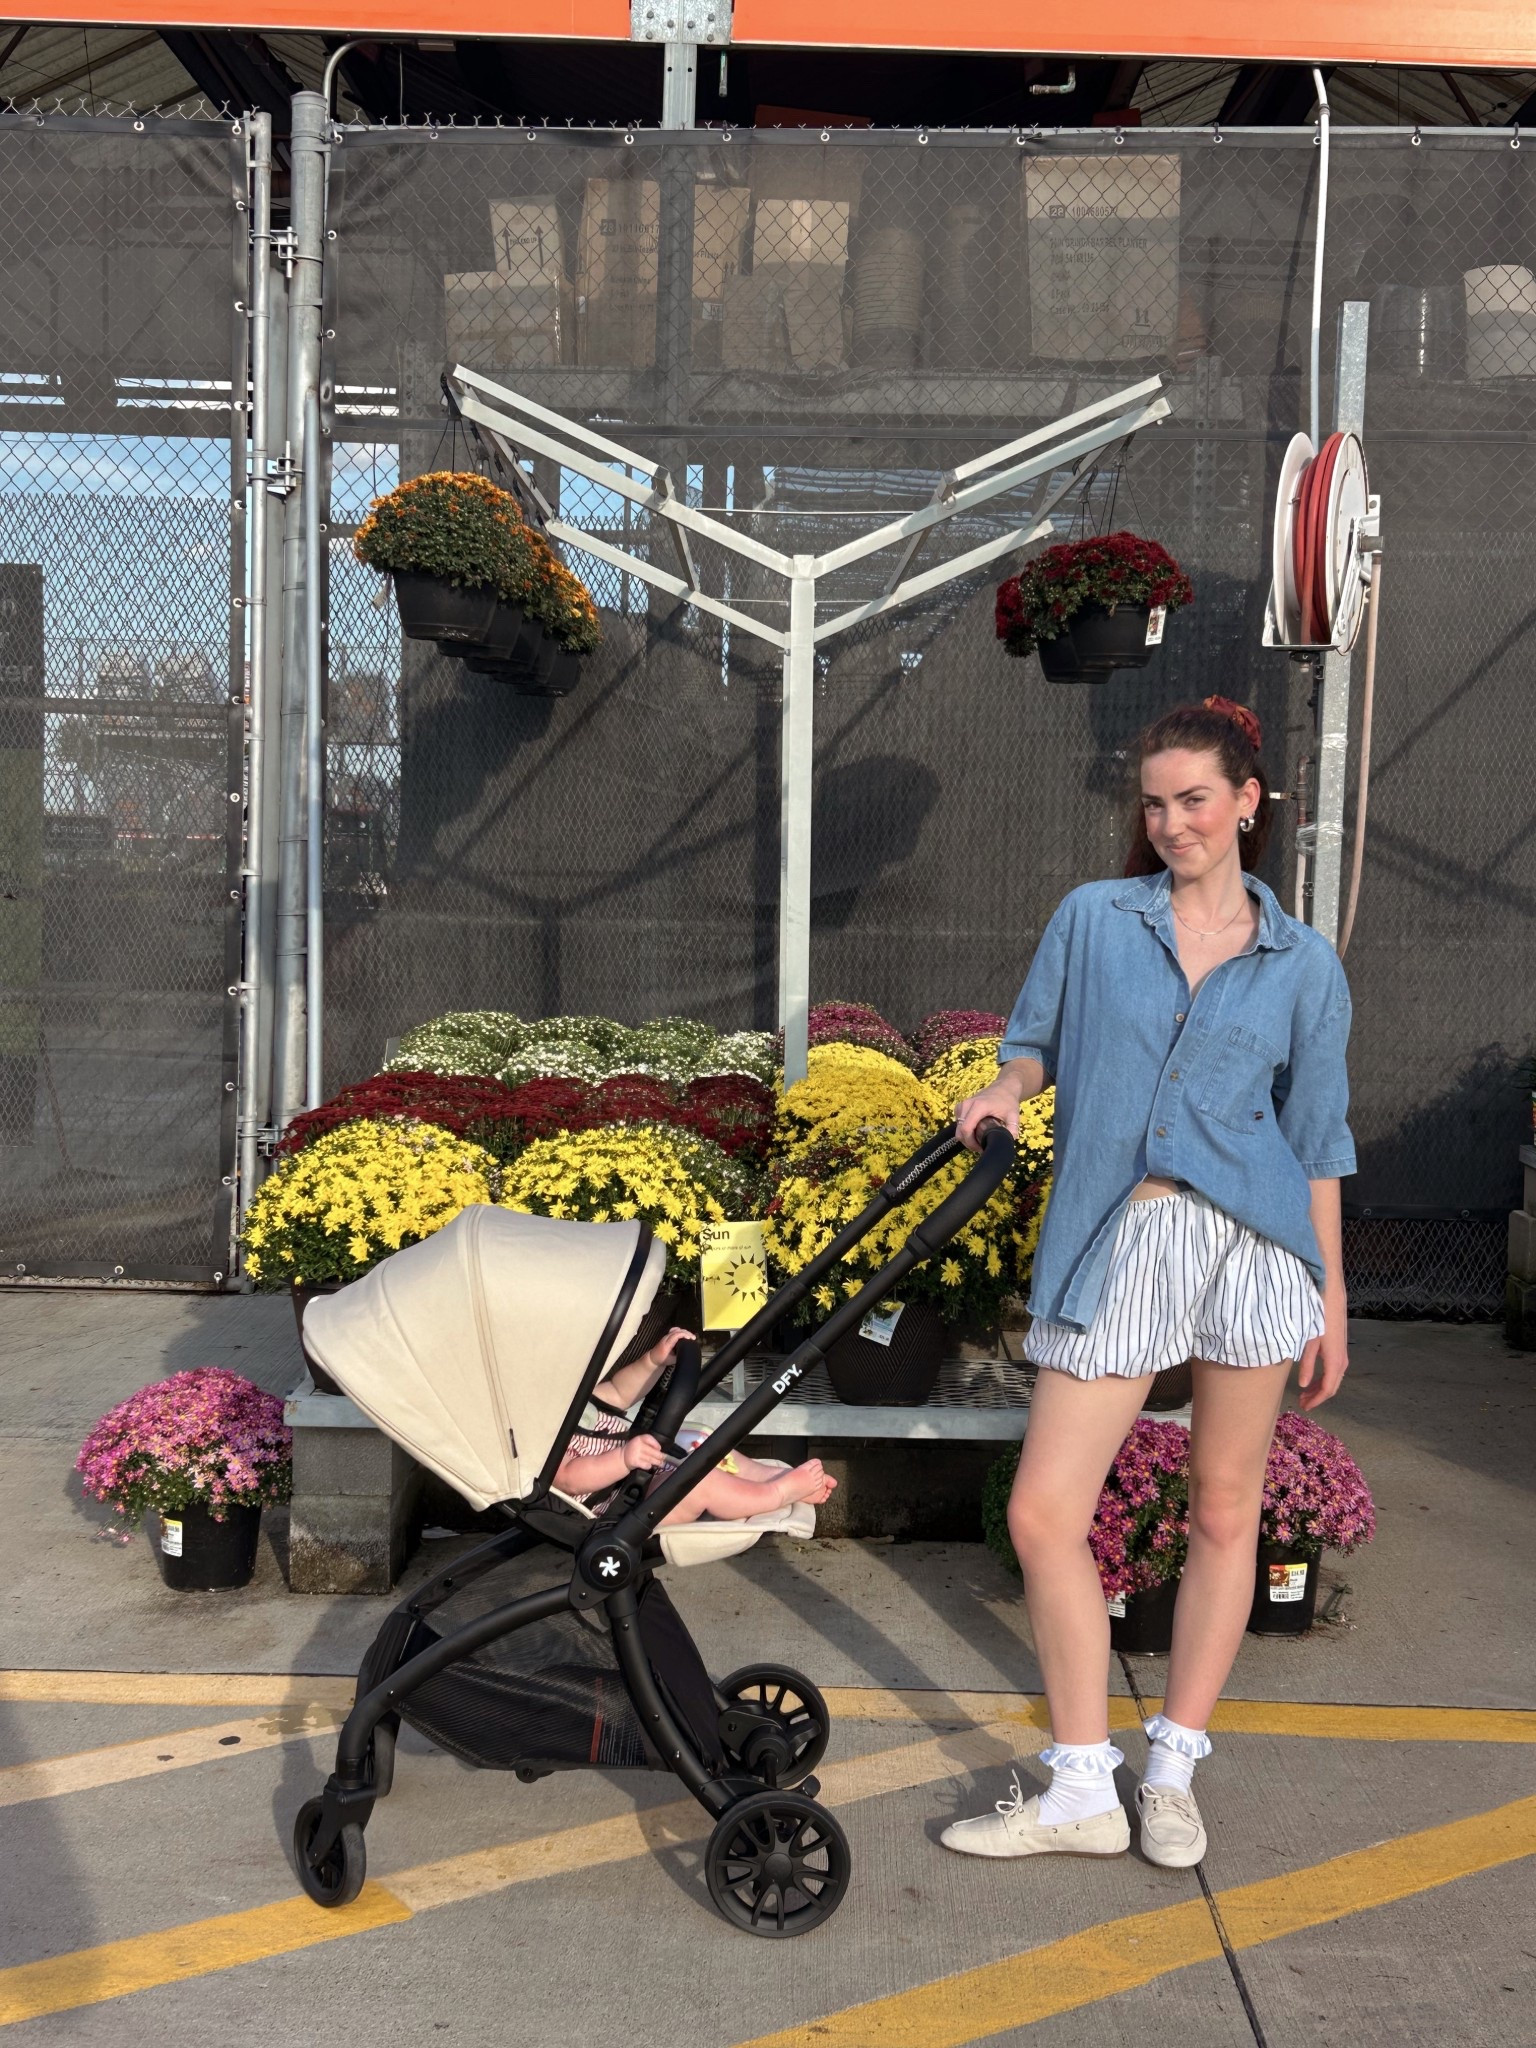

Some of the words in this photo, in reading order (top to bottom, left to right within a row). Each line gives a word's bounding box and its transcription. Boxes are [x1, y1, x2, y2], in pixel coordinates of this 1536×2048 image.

[1050, 206, 1064, 217] 28
[602, 221, 614, 233] 28
[703, 1228, 730, 1240] Sun
[771, 1363, 803, 1395] DFY.
